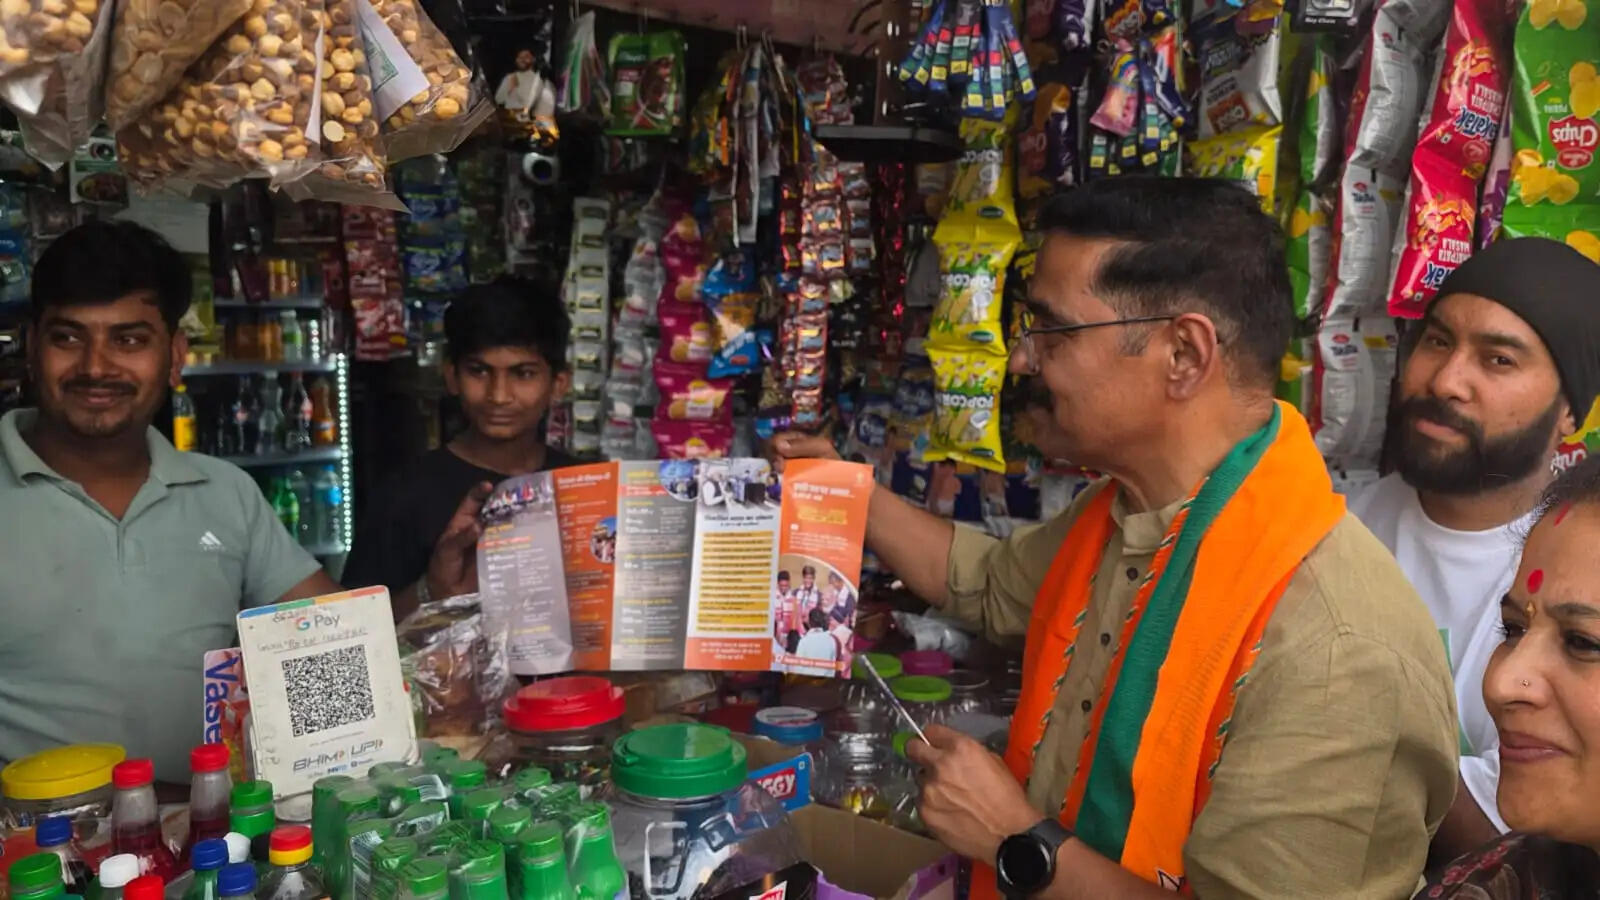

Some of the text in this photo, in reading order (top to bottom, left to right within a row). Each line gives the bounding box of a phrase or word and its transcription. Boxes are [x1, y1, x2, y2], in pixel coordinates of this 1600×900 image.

[1551, 121, 1598, 148] Chips
[314, 613, 340, 629] Pay
[293, 750, 340, 773] BHIM
[351, 739, 380, 756] UPI
